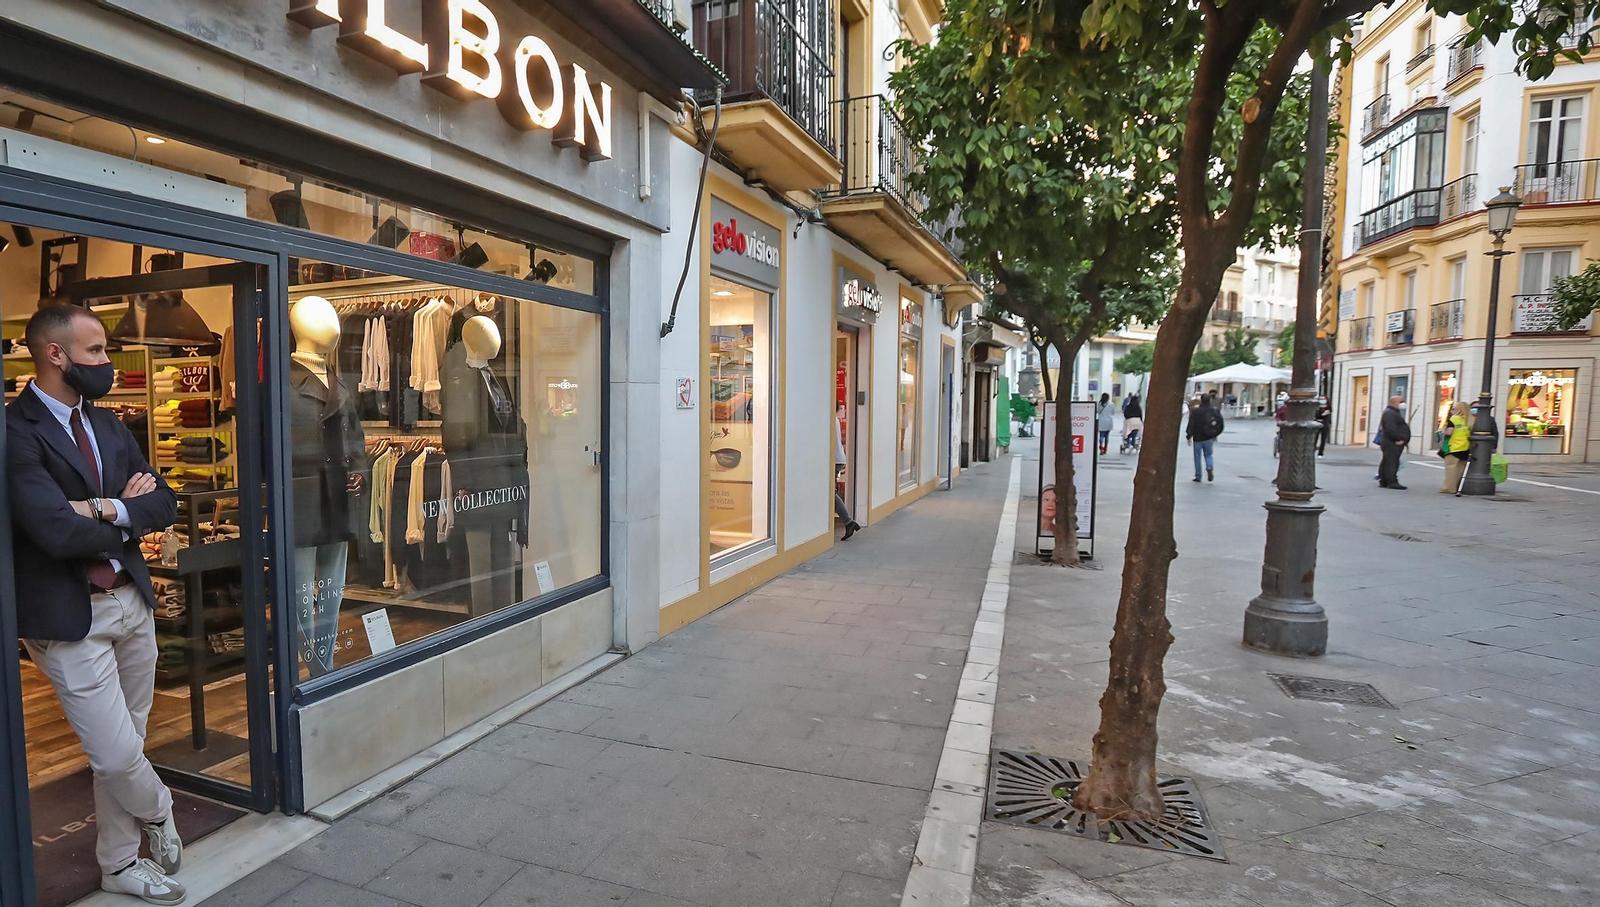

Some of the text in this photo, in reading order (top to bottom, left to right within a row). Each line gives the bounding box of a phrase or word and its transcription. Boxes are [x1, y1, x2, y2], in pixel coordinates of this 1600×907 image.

[314, 0, 612, 159] LBON
[713, 217, 779, 267] gelovision
[178, 366, 208, 377] SILBON
[419, 484, 527, 519] NEW COLLECTION
[302, 578, 333, 592] SHOP
[302, 587, 345, 604] ONLINE
[302, 605, 324, 618] 24H
